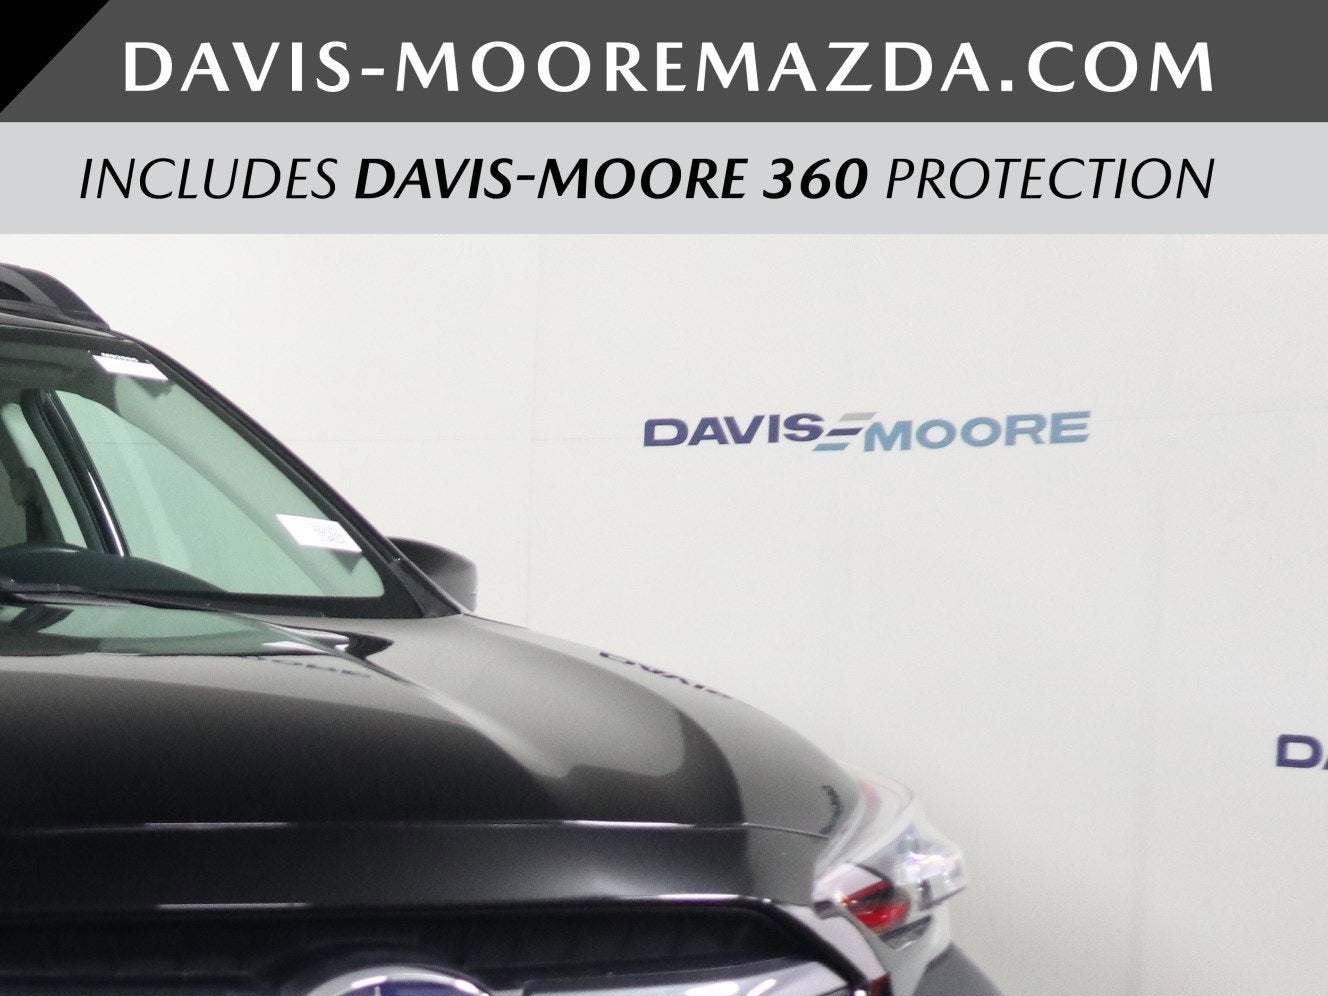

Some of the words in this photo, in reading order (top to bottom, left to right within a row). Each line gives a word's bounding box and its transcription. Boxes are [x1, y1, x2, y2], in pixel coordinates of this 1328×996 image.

[644, 413, 825, 447] DAVIS
[863, 410, 1091, 452] MOORE
[1276, 733, 1328, 771] D
